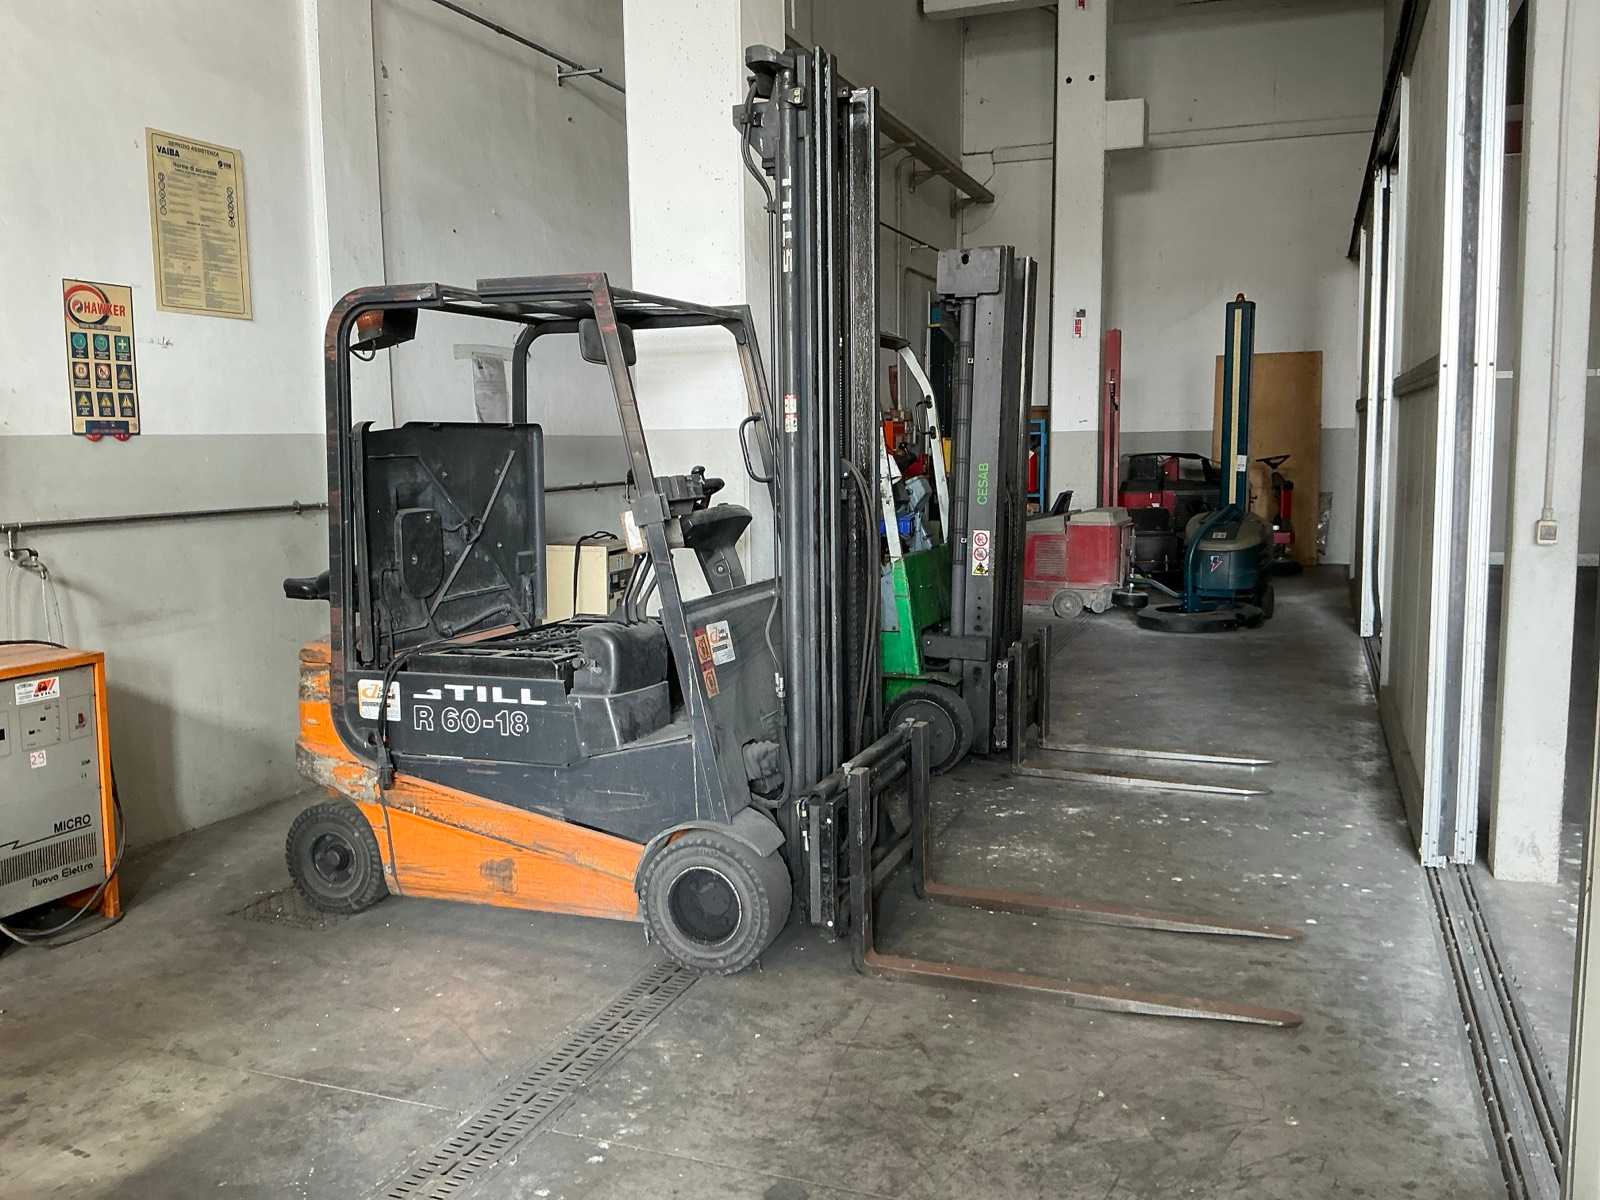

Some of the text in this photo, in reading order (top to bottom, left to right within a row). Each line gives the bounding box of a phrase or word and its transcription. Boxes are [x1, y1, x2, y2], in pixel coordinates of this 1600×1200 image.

[156, 143, 180, 158] VAIBA
[190, 145, 220, 158] ASSISTENZA
[781, 165, 793, 273] STILL
[83, 300, 126, 318] HAWKER
[976, 462, 989, 506] CESAB
[412, 683, 548, 706] STILL
[412, 704, 530, 737] R 60-18
[53, 814, 92, 834] MICRO
